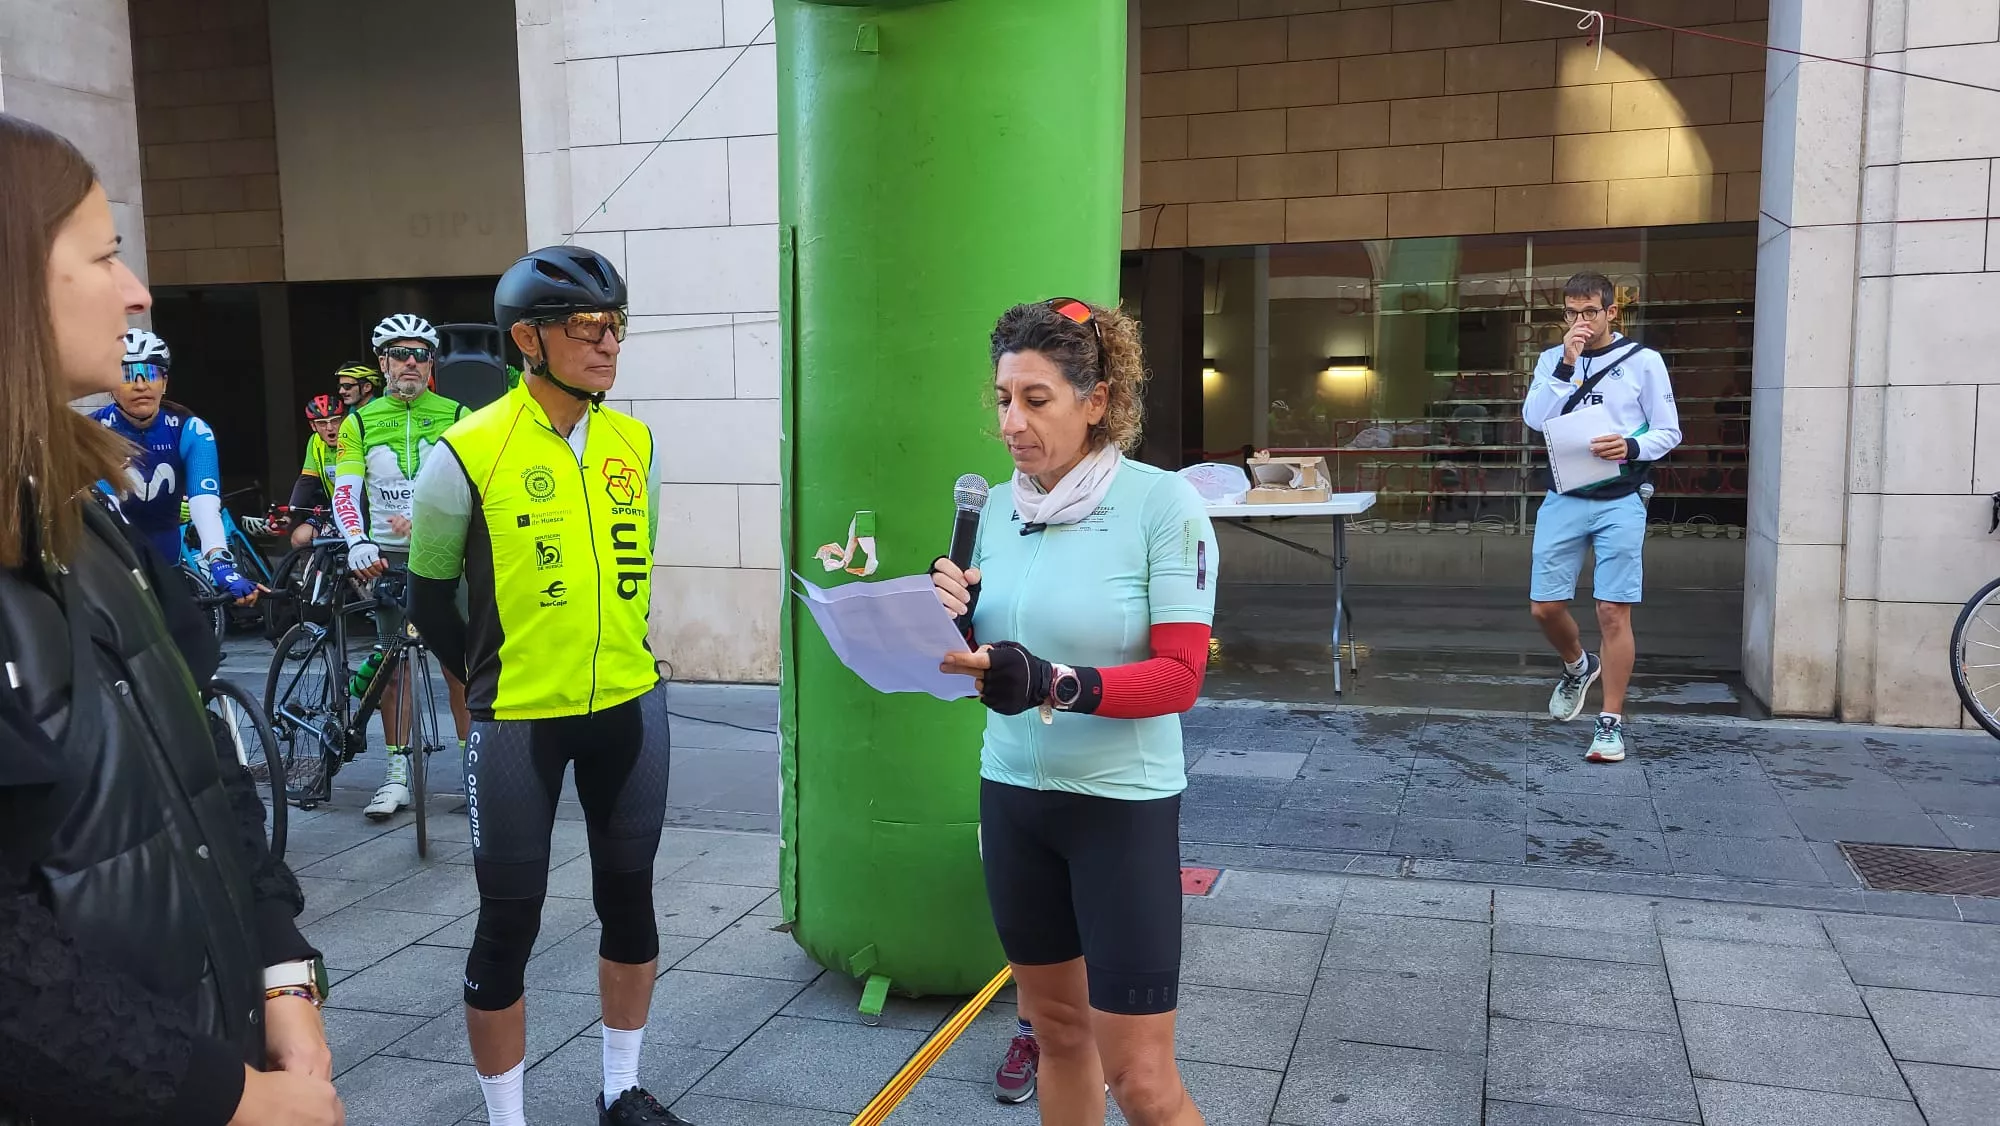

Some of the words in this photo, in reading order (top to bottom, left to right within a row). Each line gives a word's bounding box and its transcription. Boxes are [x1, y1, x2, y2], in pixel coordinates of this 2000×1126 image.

[334, 484, 361, 530] HUESCA
[611, 507, 646, 518] SPORTS
[468, 731, 481, 767] C.C.
